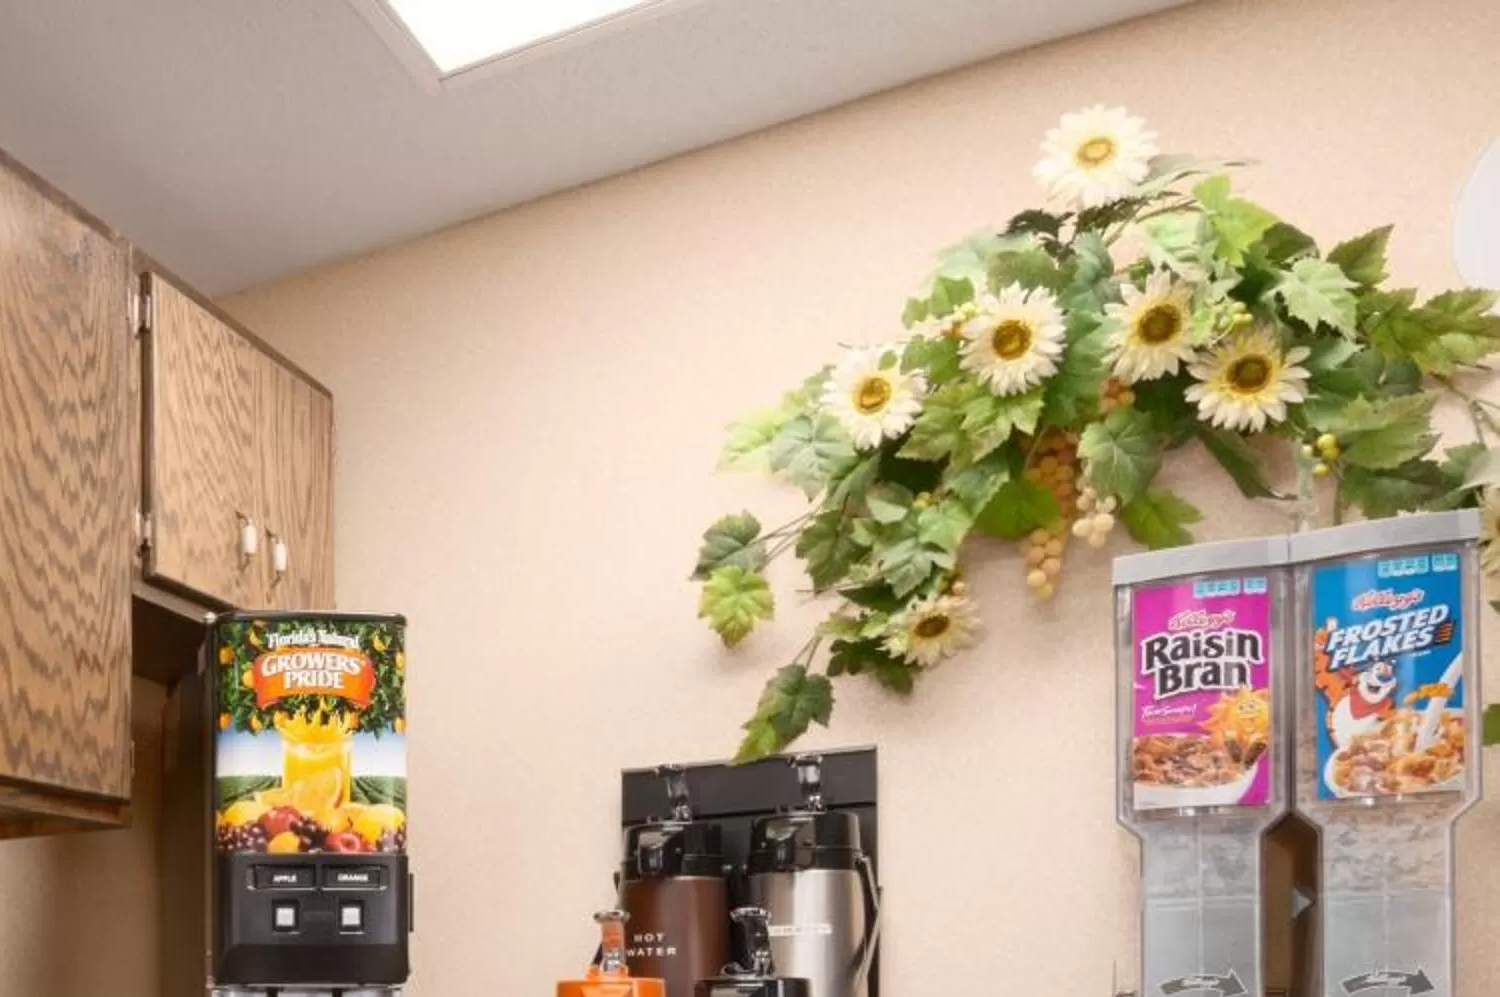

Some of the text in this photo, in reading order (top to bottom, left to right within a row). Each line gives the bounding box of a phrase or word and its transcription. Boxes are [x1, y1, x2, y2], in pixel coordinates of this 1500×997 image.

[1327, 604, 1449, 652] FROSTED
[1142, 630, 1263, 673] Raisin
[1330, 626, 1435, 670] FLAKES
[283, 670, 345, 689] PRIDE
[1156, 660, 1249, 698] Bran
[627, 947, 677, 957] WATER
[633, 931, 665, 943] HOT
